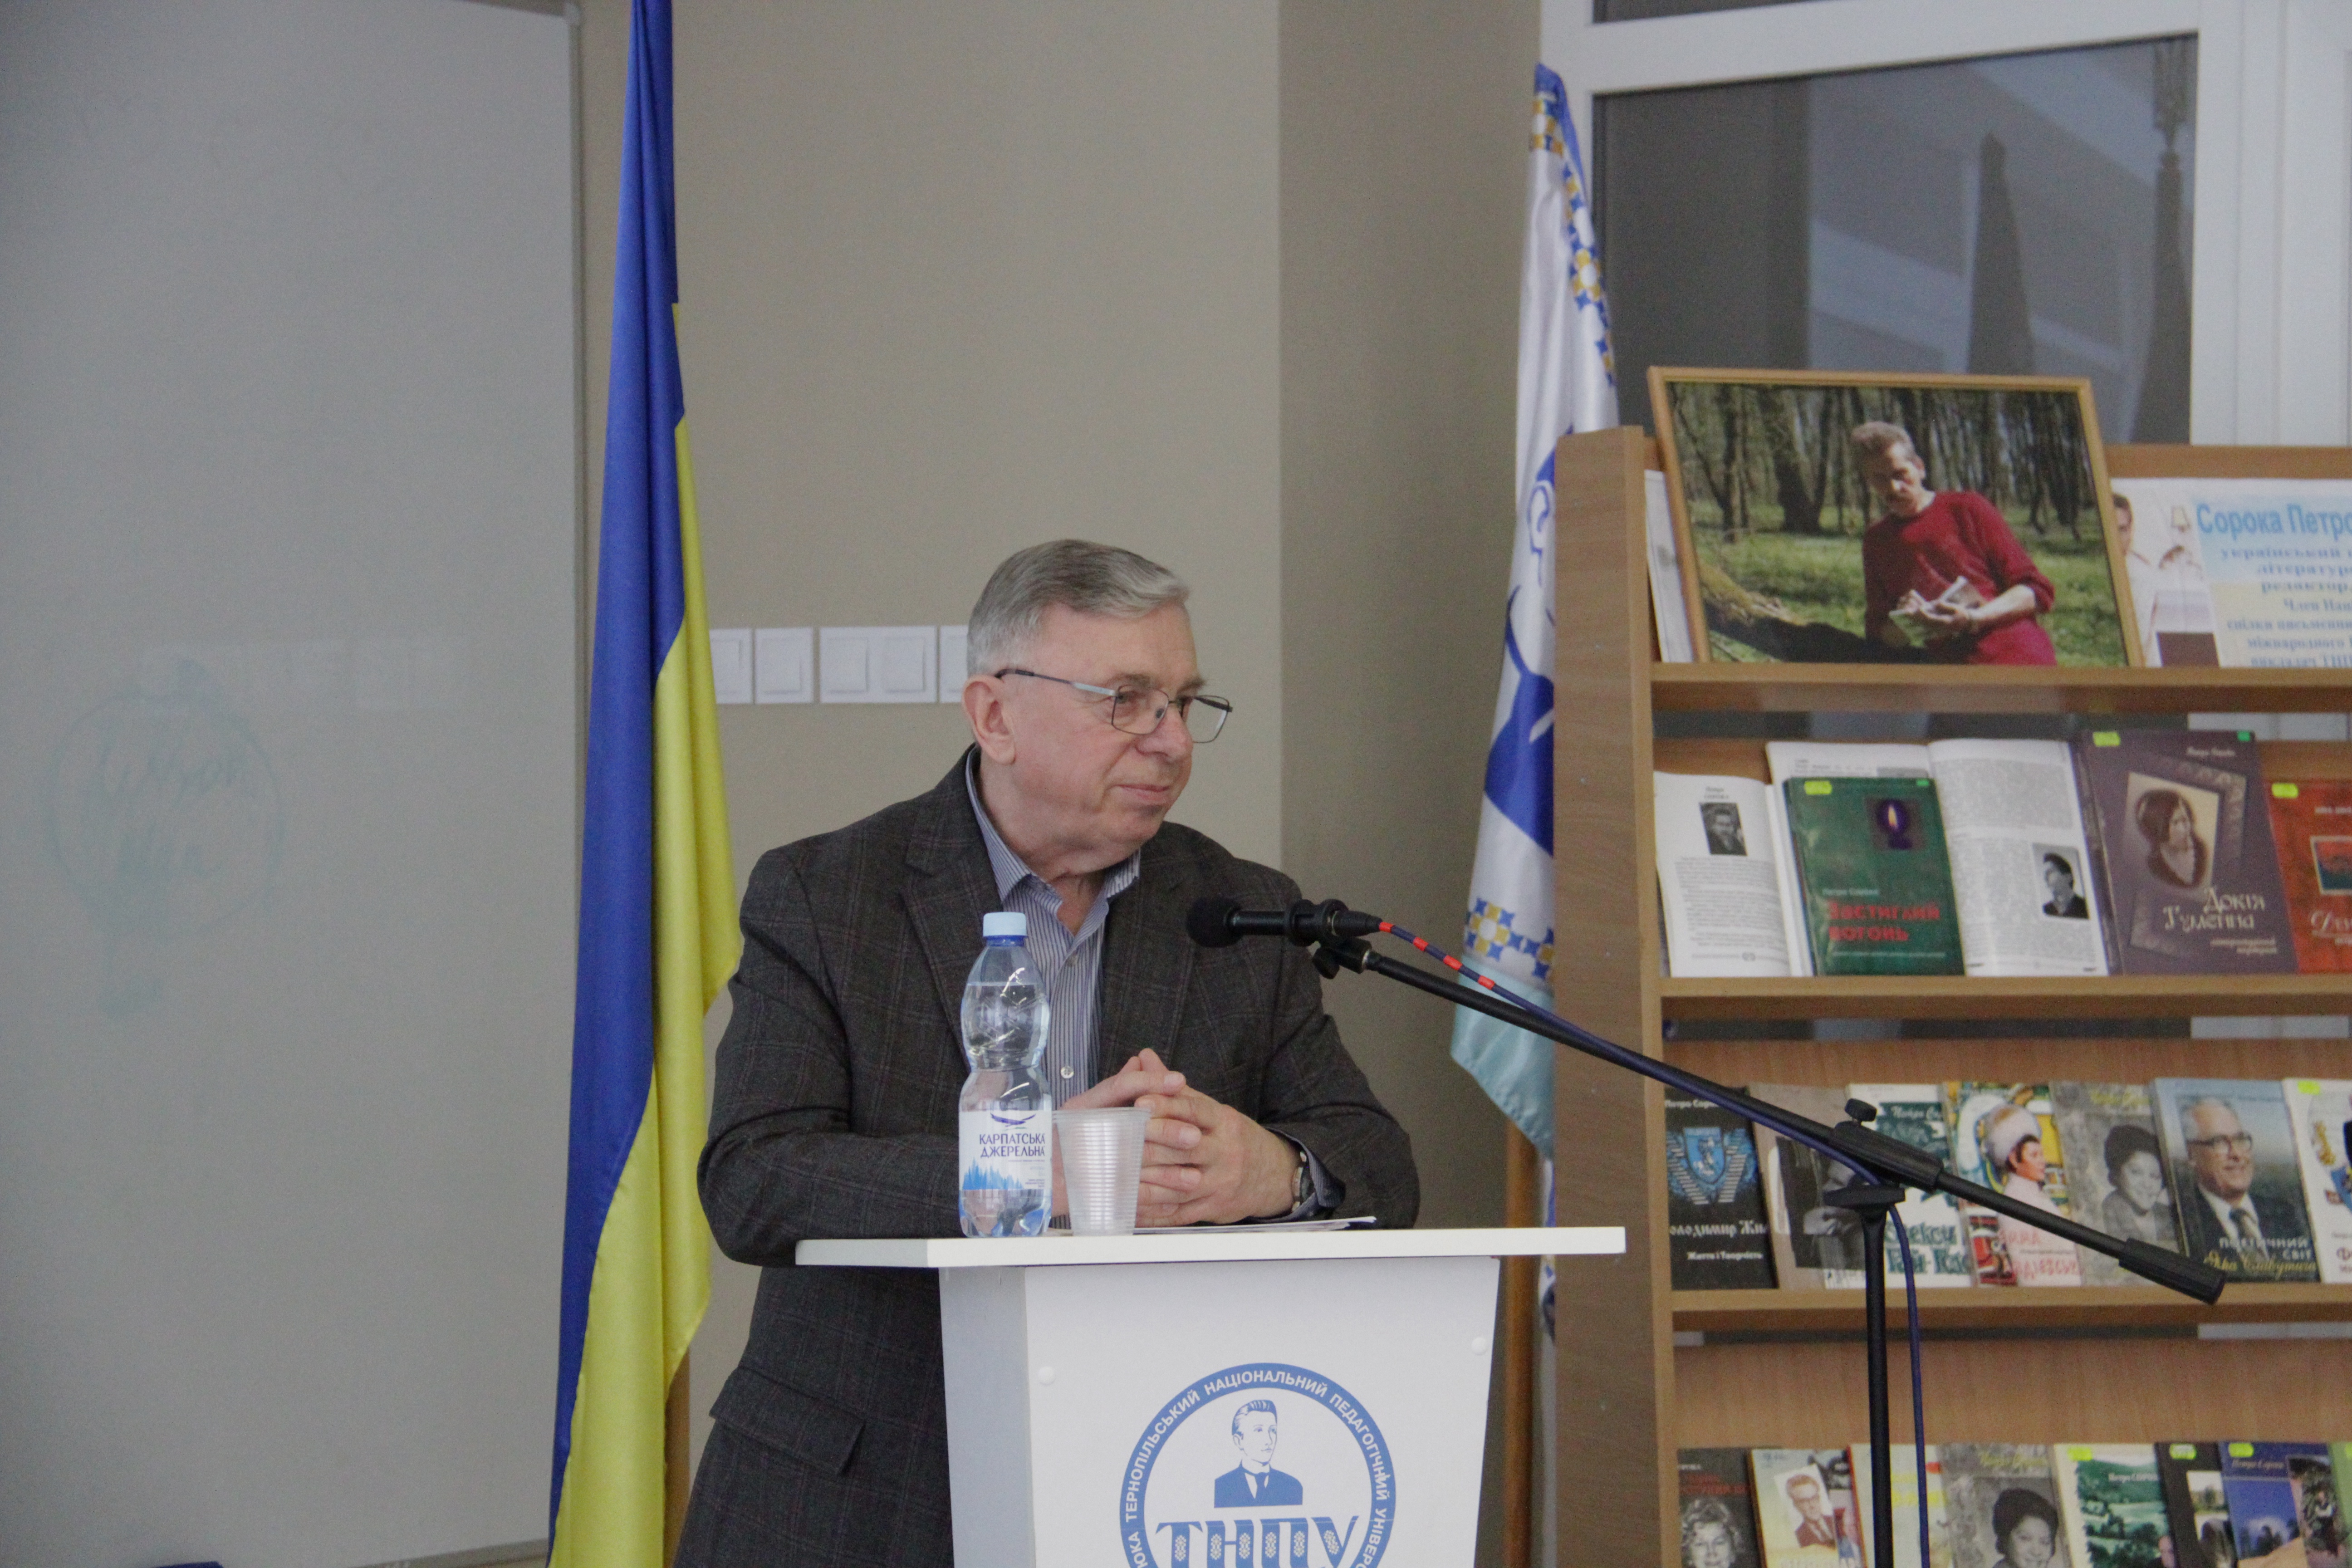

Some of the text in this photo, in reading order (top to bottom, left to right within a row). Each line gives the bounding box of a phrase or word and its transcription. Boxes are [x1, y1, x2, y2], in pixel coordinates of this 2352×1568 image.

[2196, 503, 2352, 541] Сорока Петро
[979, 1133, 1045, 1145] КАРПАТСЬКА
[980, 1146, 1045, 1159] ДЖЕРЕЛЬНА
[1125, 1388, 1201, 1523] ТЕРНОПІЛЬСЬКИЙ
[1203, 1370, 1328, 1398] НАЦІОНАЛЬНИЙ
[1329, 1393, 1391, 1500] ПЕДАГОГІЧНИЙ
[1155, 1515, 1360, 1568] ТНПУ
